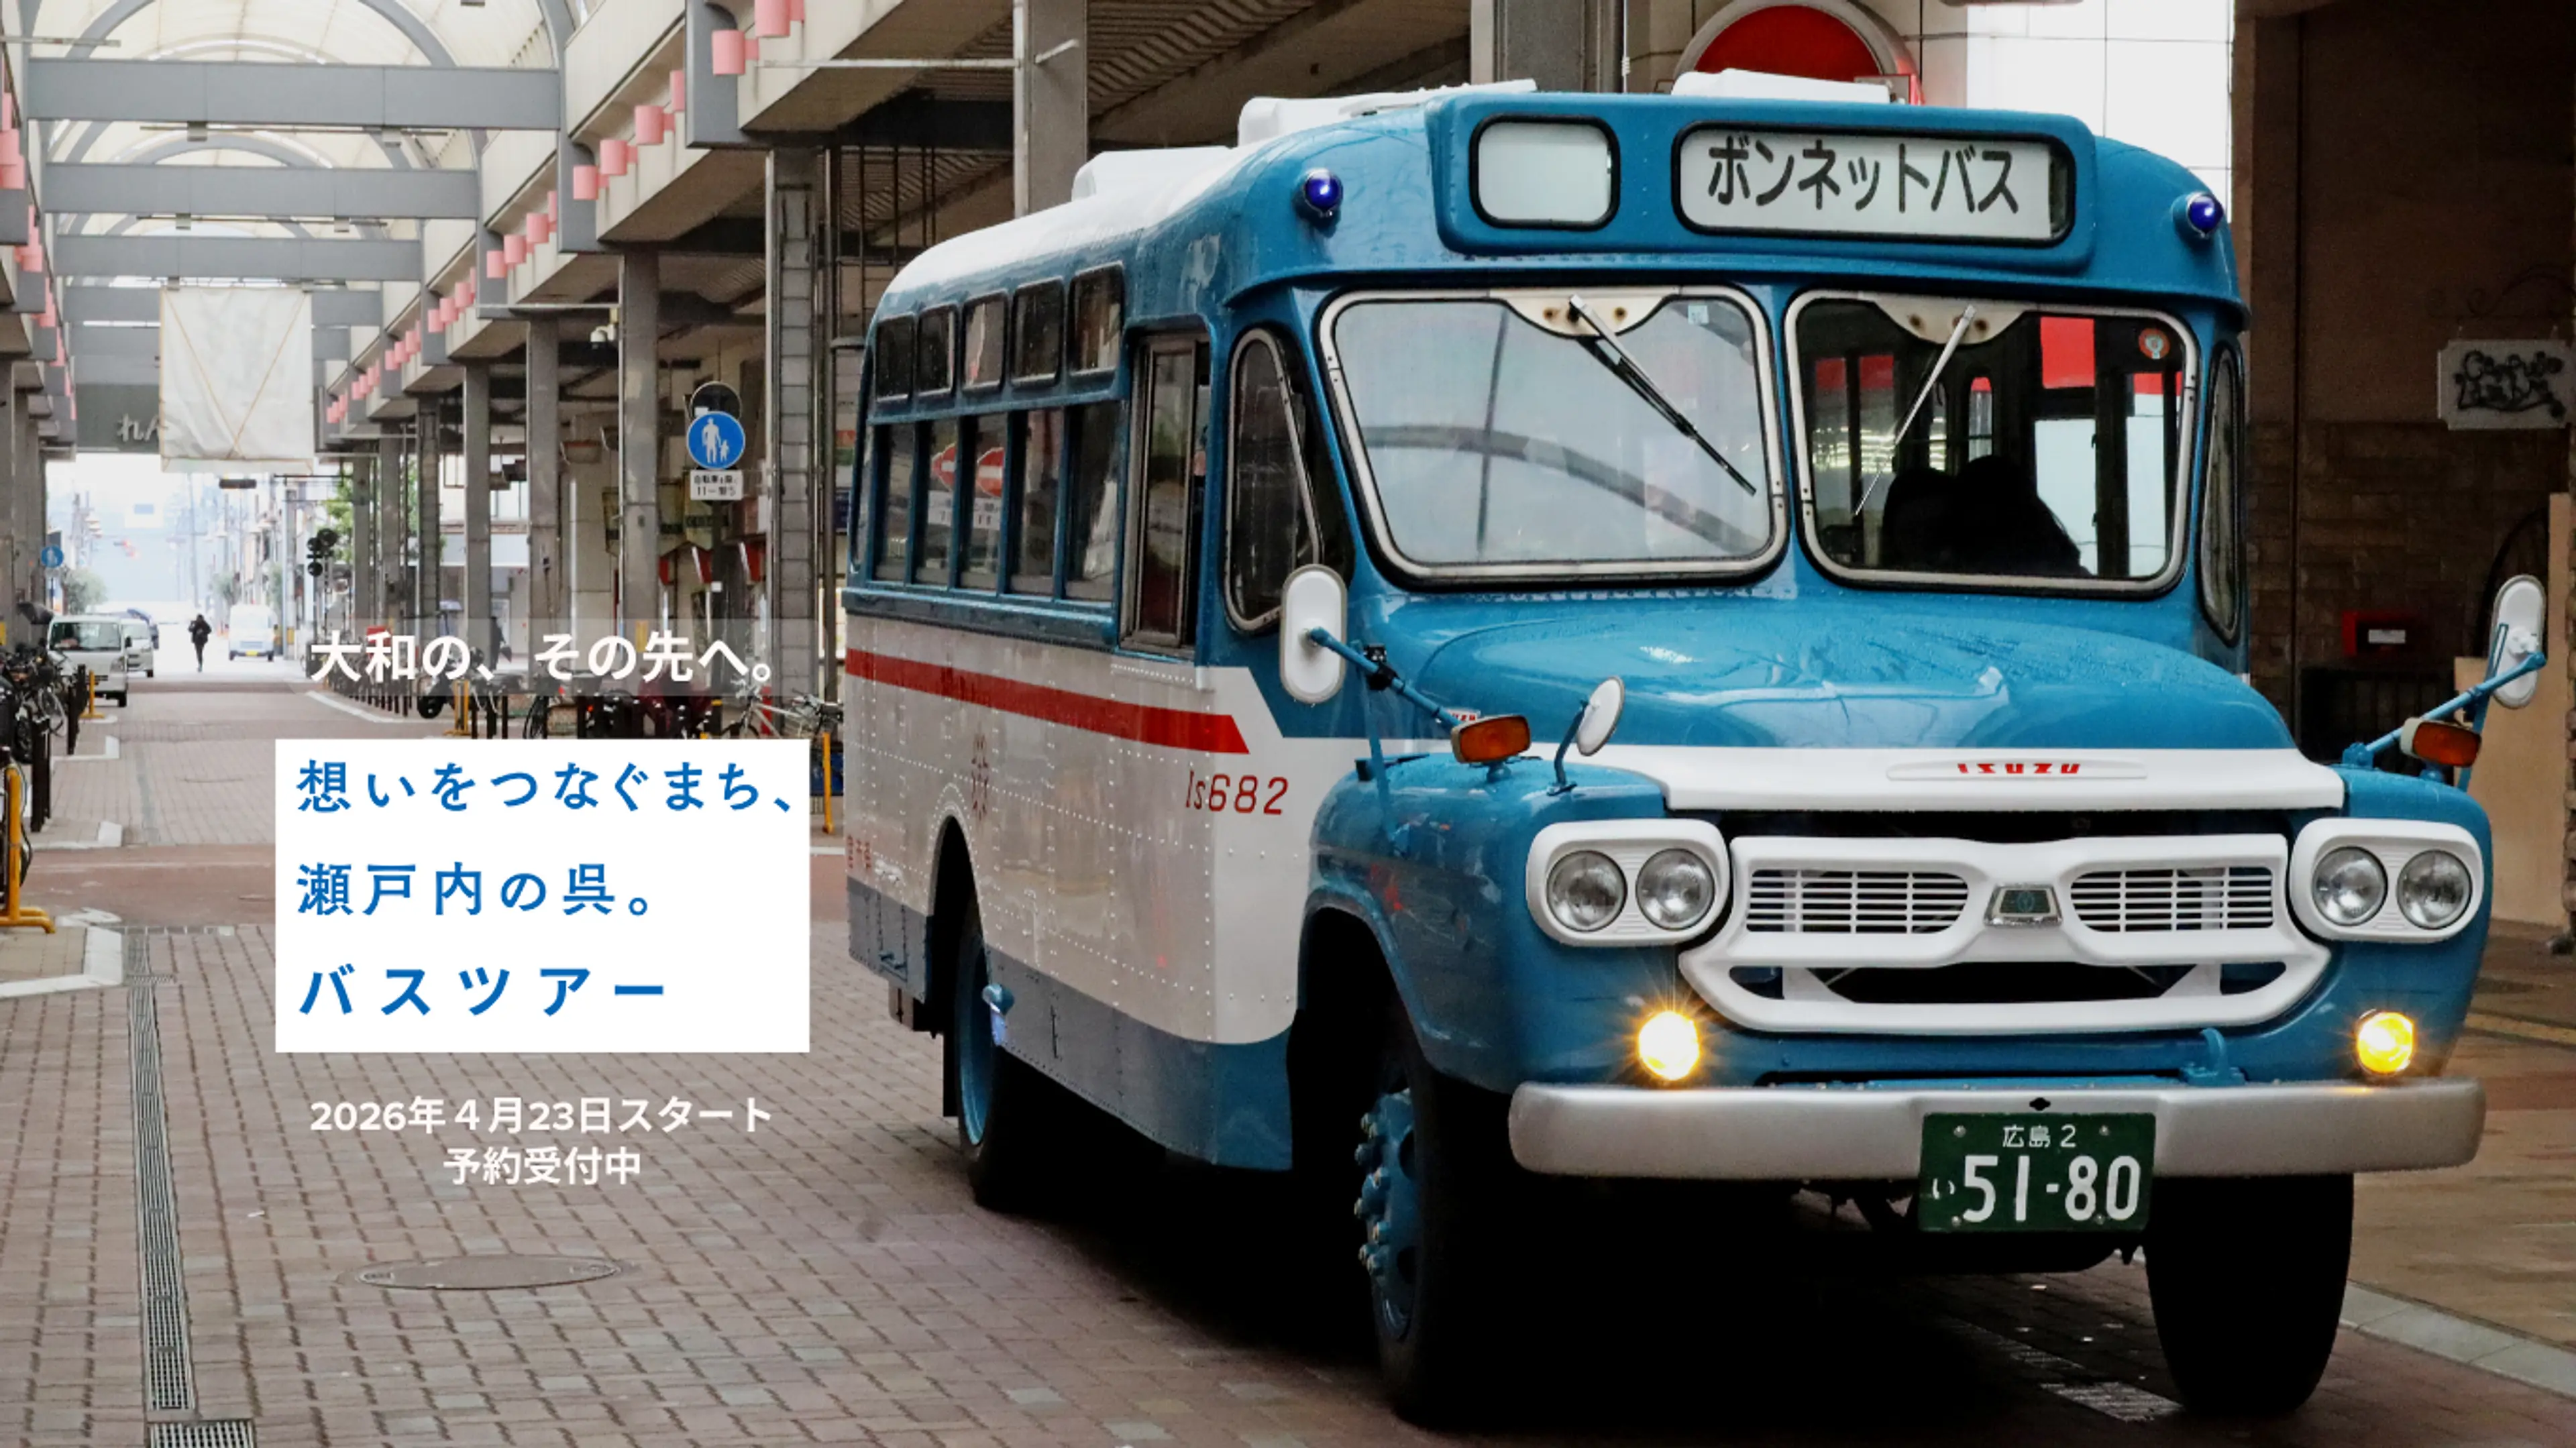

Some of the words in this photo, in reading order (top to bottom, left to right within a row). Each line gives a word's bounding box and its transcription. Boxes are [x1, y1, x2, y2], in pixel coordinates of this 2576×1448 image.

[1707, 135, 2018, 213] ボンネットバス
[1957, 763, 2080, 774] ISUZU
[2003, 1125, 2051, 1148] 広島
[2060, 1124, 2076, 1148] 2
[1963, 1155, 2141, 1222] 51-80
